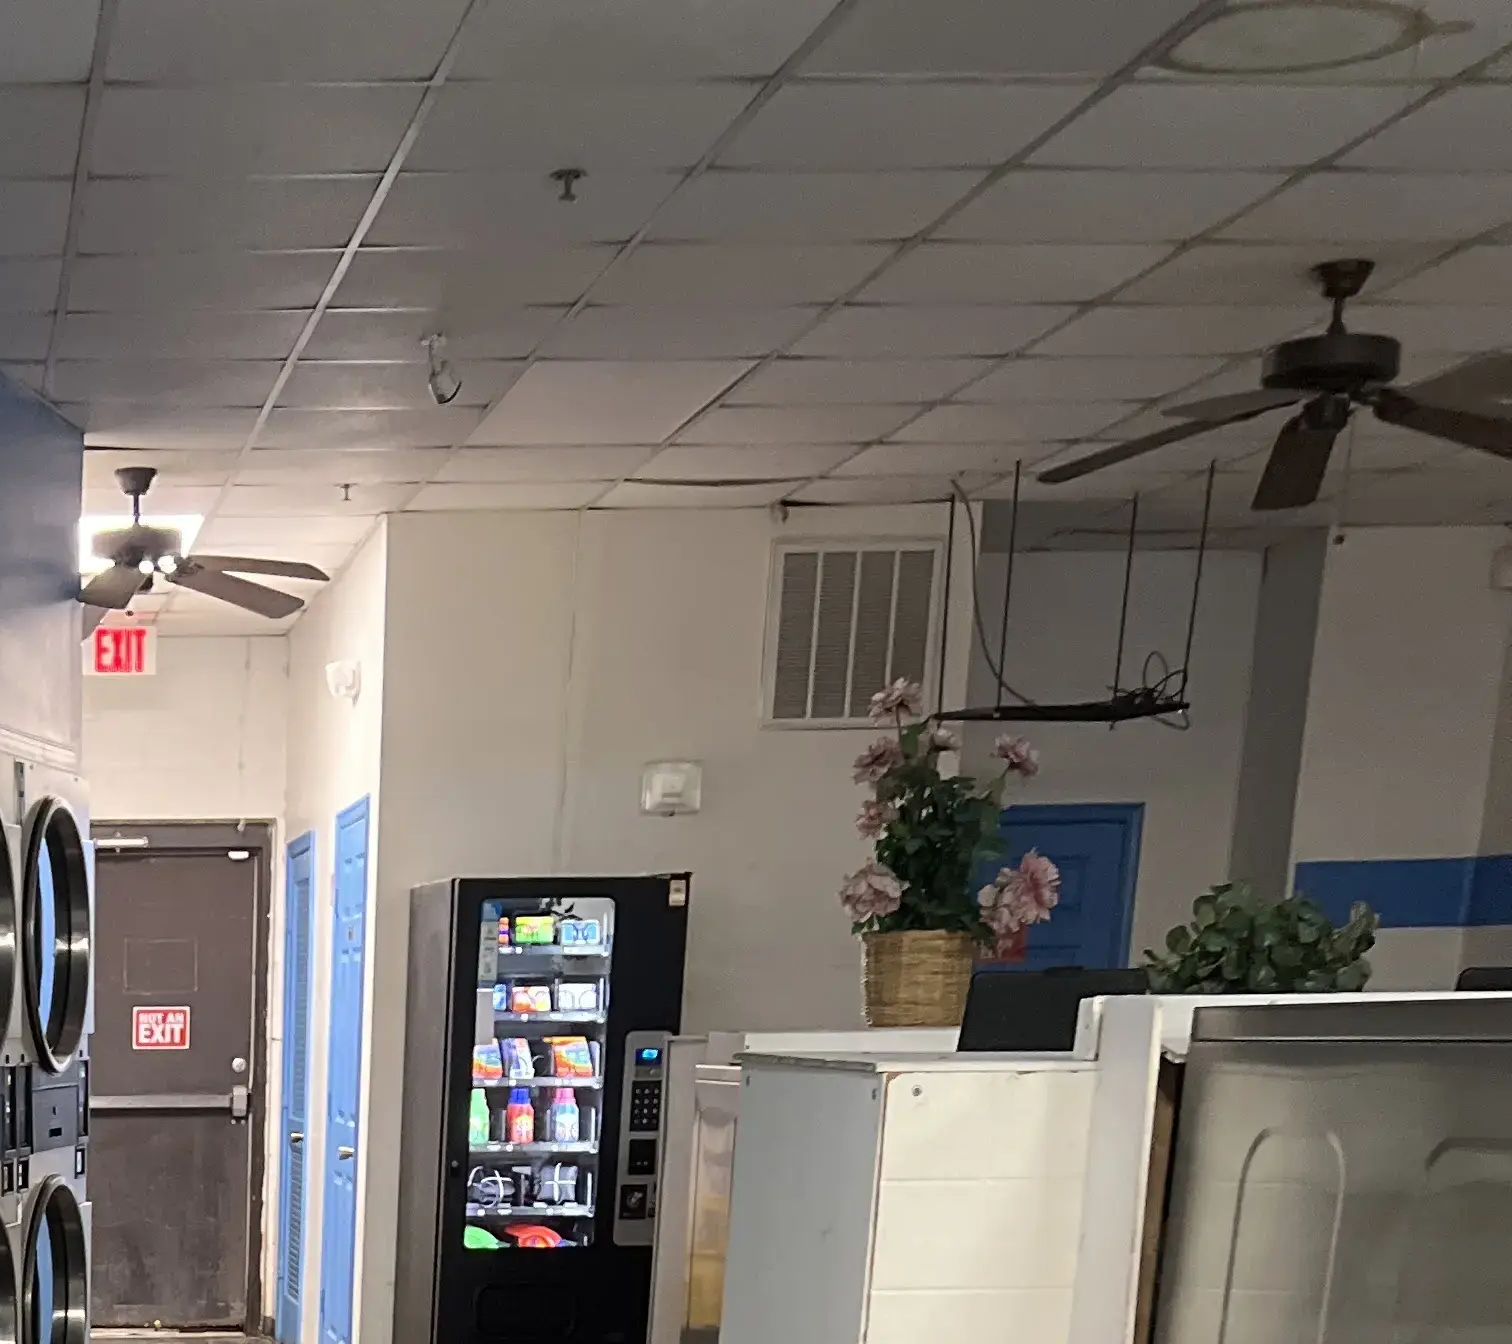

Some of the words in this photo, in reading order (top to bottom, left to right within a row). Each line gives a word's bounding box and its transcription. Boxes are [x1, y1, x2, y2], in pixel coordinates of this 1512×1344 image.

[95, 629, 147, 673] EXIT
[138, 1012, 164, 1024] NOT
[166, 1012, 185, 1024] AN
[138, 1023, 185, 1044] EXIT
